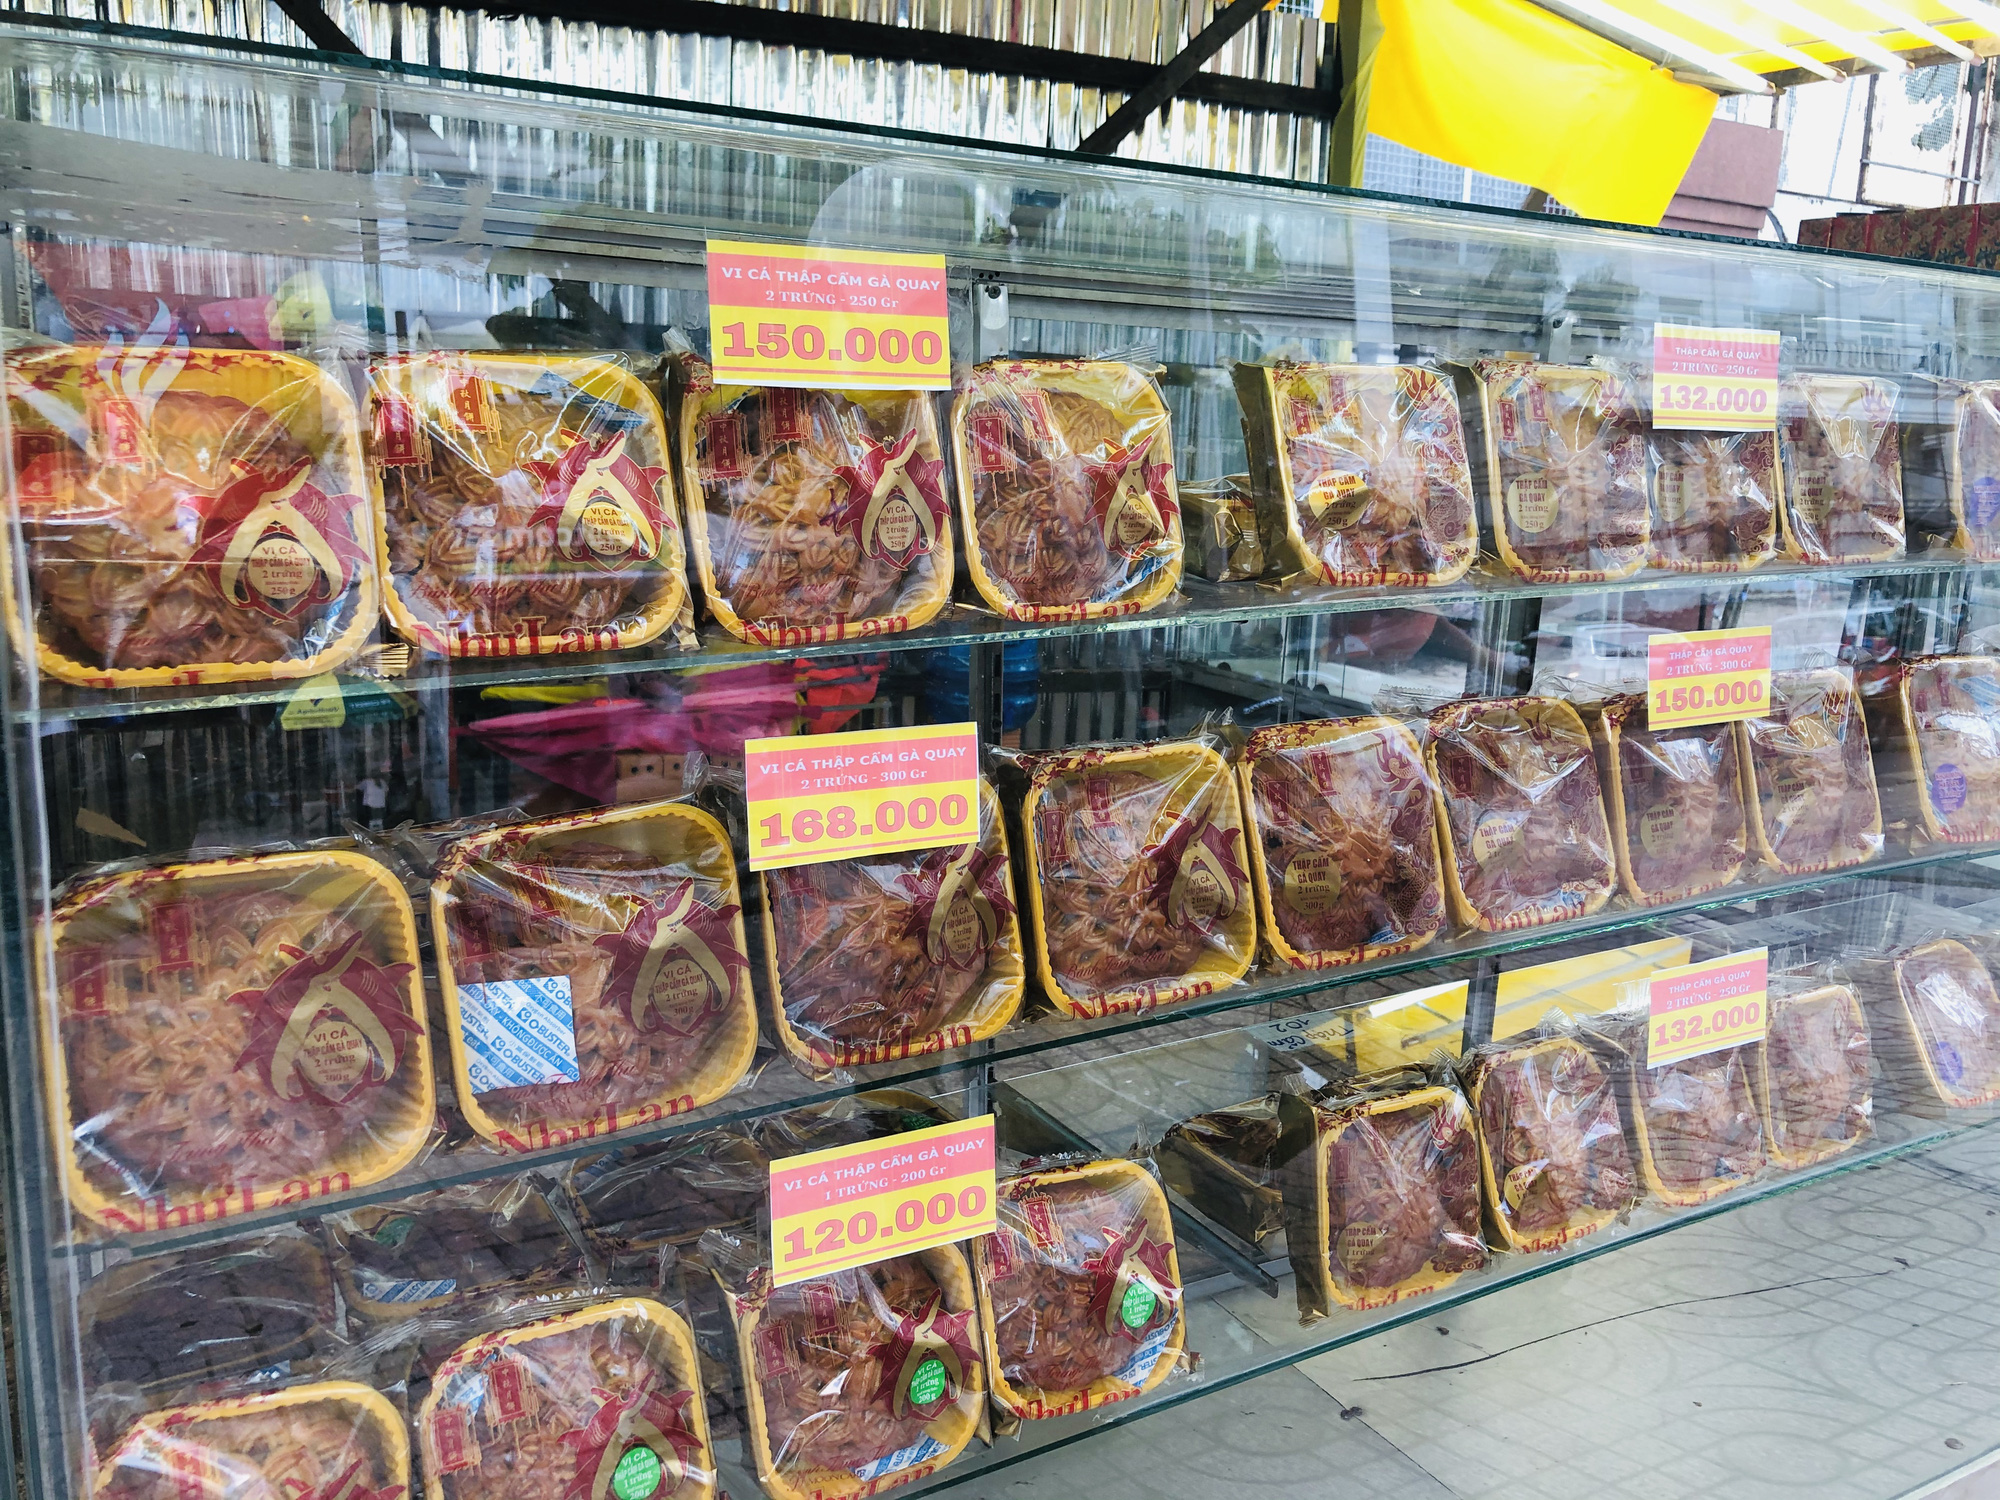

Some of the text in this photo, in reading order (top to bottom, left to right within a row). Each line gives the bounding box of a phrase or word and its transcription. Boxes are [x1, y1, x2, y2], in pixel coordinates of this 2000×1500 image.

[722, 267, 742, 279] VI
[748, 267, 771, 281] CÁ
[776, 270, 821, 284] THẬP
[868, 274, 891, 289] GÀ
[896, 278, 941, 291] QUAY
[766, 291, 774, 301] 2
[779, 289, 836, 304] TRỨNG
[849, 295, 877, 307] 250
[881, 297, 899, 308] Gr
[722, 322, 942, 364] 150.000
[1676, 347, 1698, 358] THẬP
[1722, 350, 1734, 359] GÀ
[1737, 351, 1760, 360] QUAY
[1660, 385, 1767, 412] 132.000
[1670, 650, 1692, 660] THẬP
[1715, 646, 1727, 655] GÀ
[1730, 645, 1753, 655] QUAY
[1667, 667, 1673, 675] 2
[1675, 662, 1712, 674] TRỨNG
[1720, 660, 1738, 670] 300
[1741, 659, 1752, 668] Gr
[1656, 679, 1763, 713] 150.000
[760, 763, 779, 775] VI
[785, 758, 806, 773] CÁ
[811, 756, 854, 769] THẬP
[899, 749, 919, 762] GÀ
[924, 747, 967, 761] QUAY
[801, 780, 810, 790] 2
[814, 773, 868, 788] TRỨNG
[881, 770, 907, 782] 300
[911, 769, 927, 779] Gr
[760, 794, 968, 847] 168.000
[1669, 983, 1691, 994] THẬP
[1714, 974, 1725, 984] GÀ
[1728, 971, 1751, 981] QUAY
[1655, 1002, 1760, 1047] 132.000
[784, 1179, 803, 1192] VI
[808, 1172, 829, 1187] CÁ
[834, 1163, 875, 1181] THẬP
[918, 1147, 939, 1161] GÀ
[944, 1139, 985, 1156] QUAY
[826, 1190, 831, 1200] 1
[836, 1177, 888, 1198] TRỨNG
[901, 1169, 926, 1184] 200
[930, 1166, 947, 1176] Gr
[784, 1185, 986, 1262] 120.000
